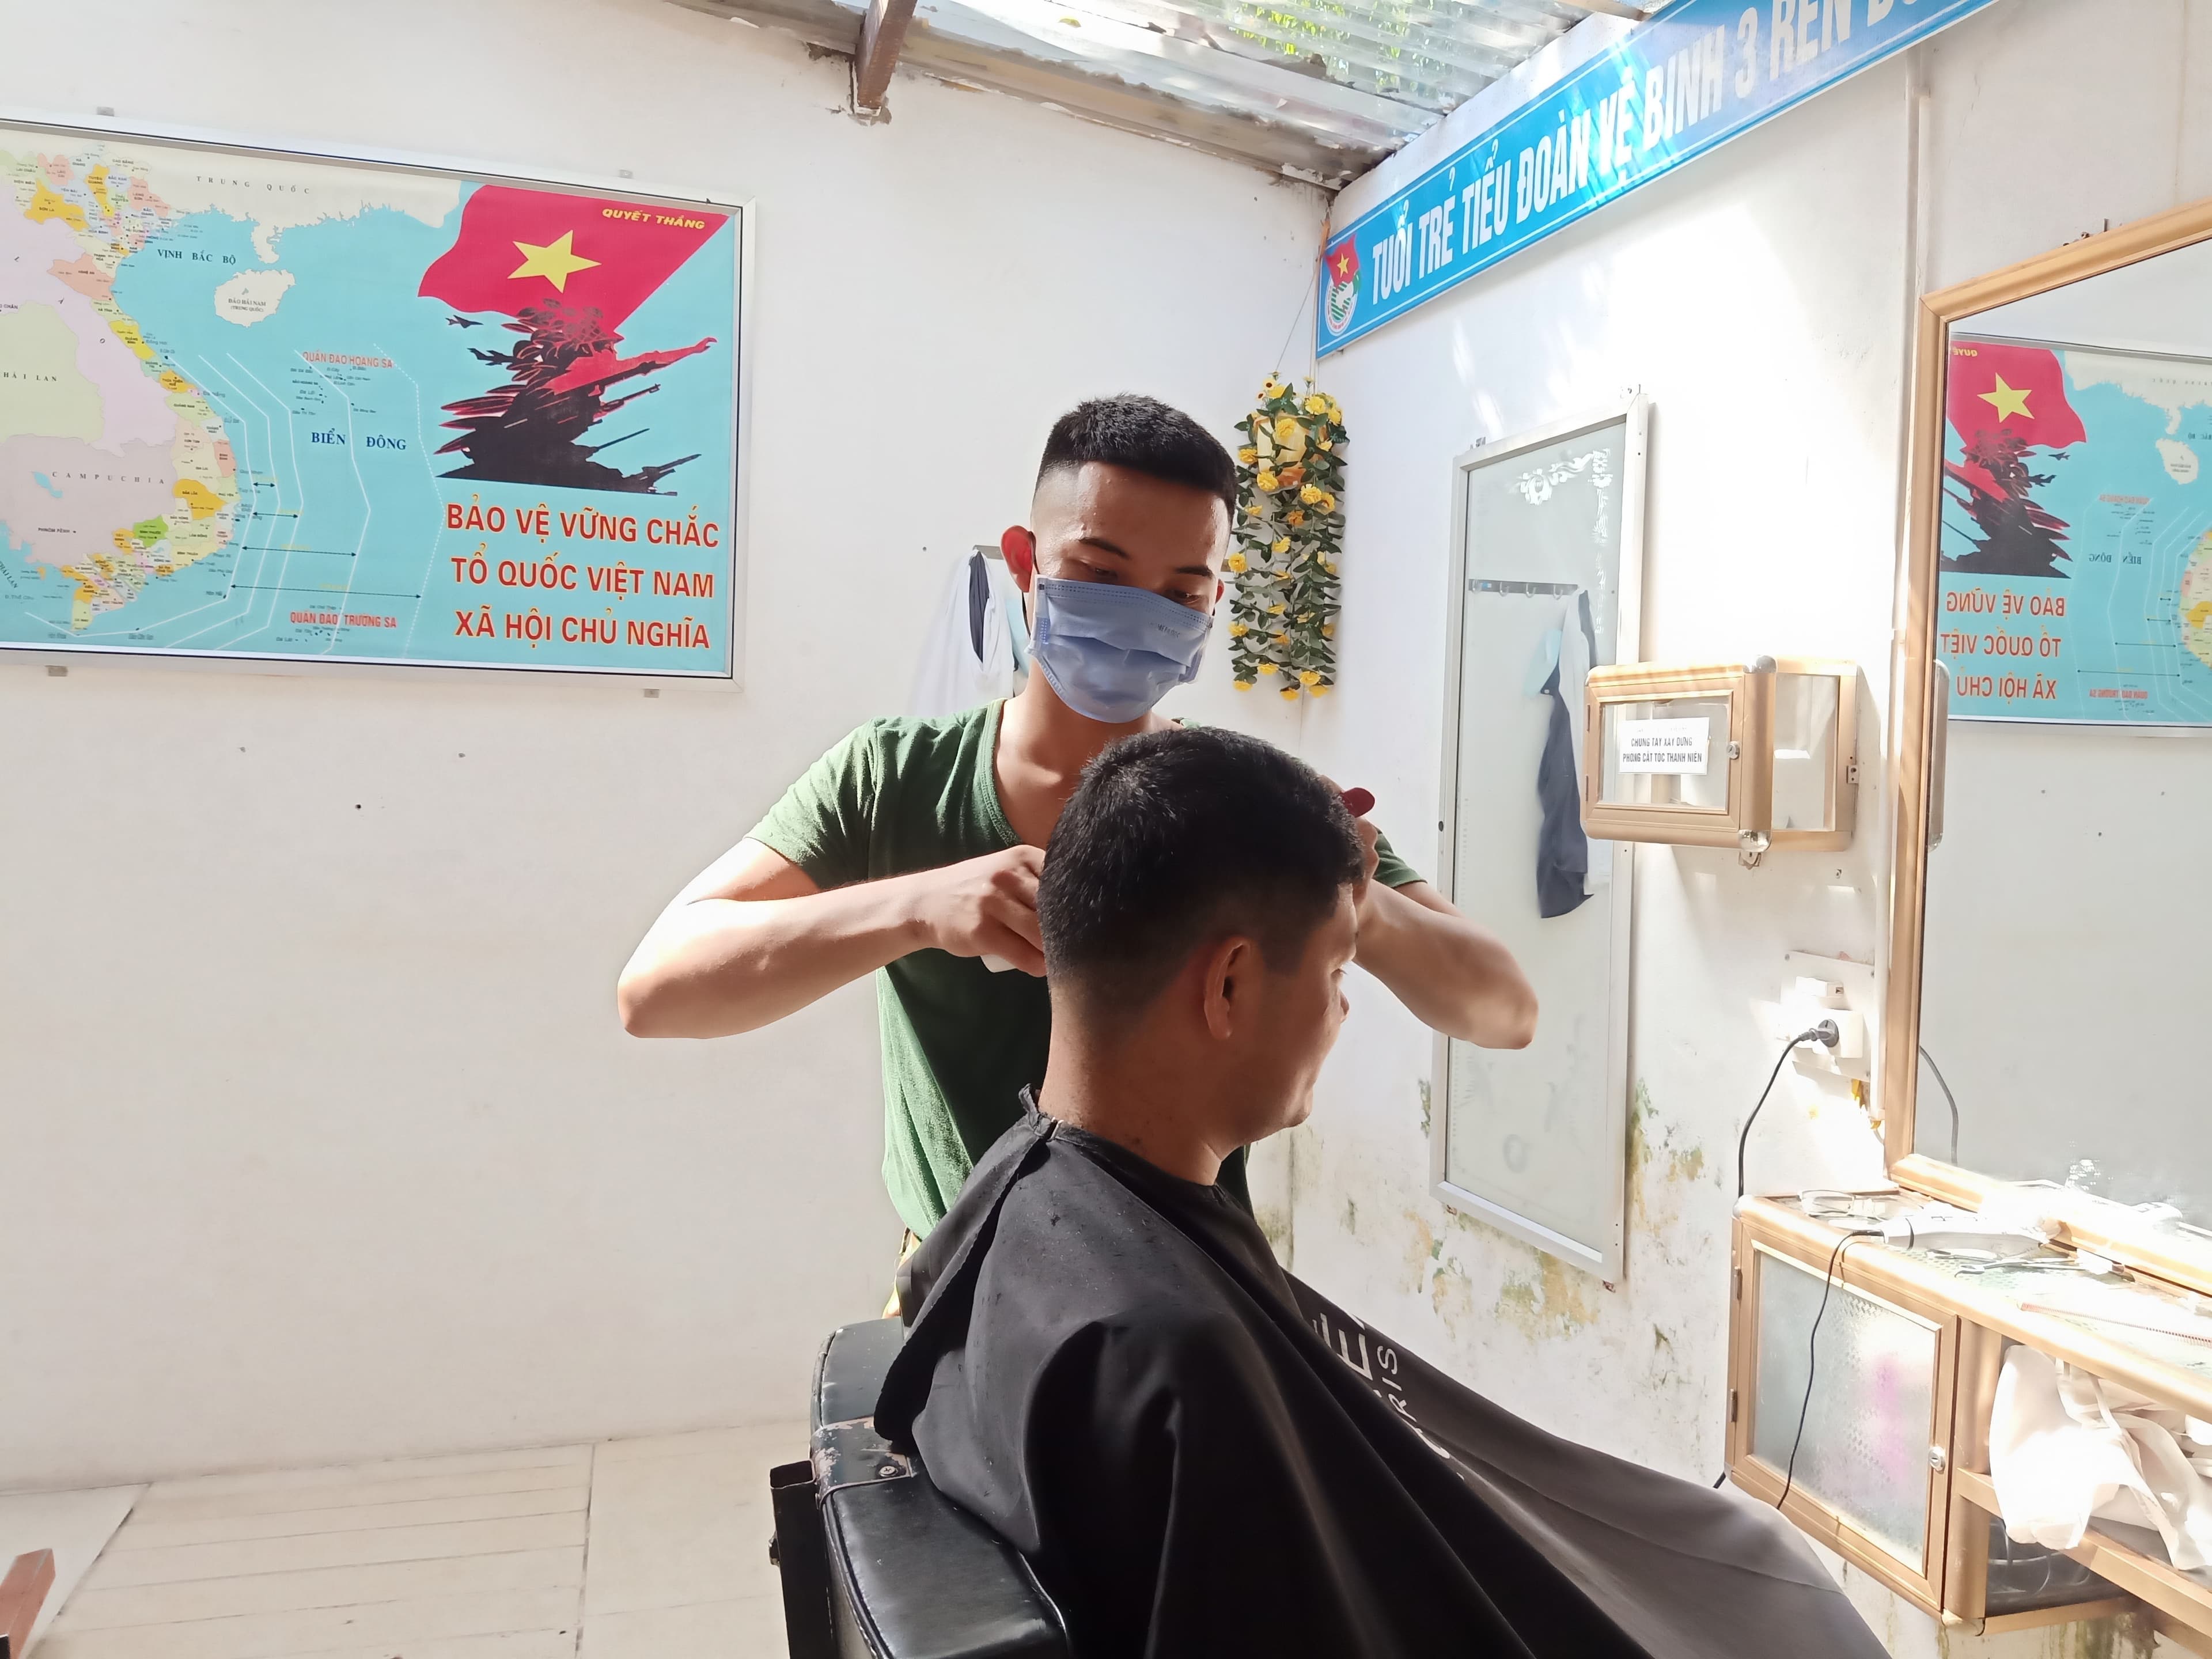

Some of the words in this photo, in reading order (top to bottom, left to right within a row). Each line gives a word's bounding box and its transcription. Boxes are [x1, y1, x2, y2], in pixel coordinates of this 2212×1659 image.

[1372, 199, 1412, 305] TUỔI
[1419, 166, 1456, 279] TRẺ
[1462, 139, 1511, 255] TIỂU
[1516, 108, 1591, 225] ĐOÀN
[1643, 24, 1725, 152] BINH
[1735, 7, 1758, 99] 3
[196, 176, 250, 187] TRUNG
[267, 184, 309, 194] QUỐC
[602, 209, 651, 222] QUYẾT
[656, 214, 705, 230] THẮNG
[157, 249, 182, 259] VỊNH
[192, 250, 213, 262] BẮC
[222, 255, 236, 265] BỘ
[382, 358, 393, 369] SA
[312, 428, 346, 445] BIỂN
[366, 434, 406, 450] ĐÔNG
[52, 472, 164, 484] CAMPUCHIA
[446, 494, 506, 533] BẢO
[516, 503, 550, 543] VỆ
[560, 507, 636, 542] VỮNG
[646, 505, 719, 548] CHẮC
[450, 543, 488, 585] TỔ
[498, 552, 577, 590] QUỐC
[587, 561, 644, 601] VIỆT
[654, 571, 714, 599] NAM
[384, 617, 397, 628] SA
[454, 605, 495, 638] XÃ
[505, 608, 552, 648] HỘI
[562, 608, 617, 645] CHỦ
[627, 617, 710, 649] NGHĨA
[1631, 738, 1650, 747] CHUNG
[1652, 737, 1662, 747] TAY
[1667, 752, 1685, 763] THANH
